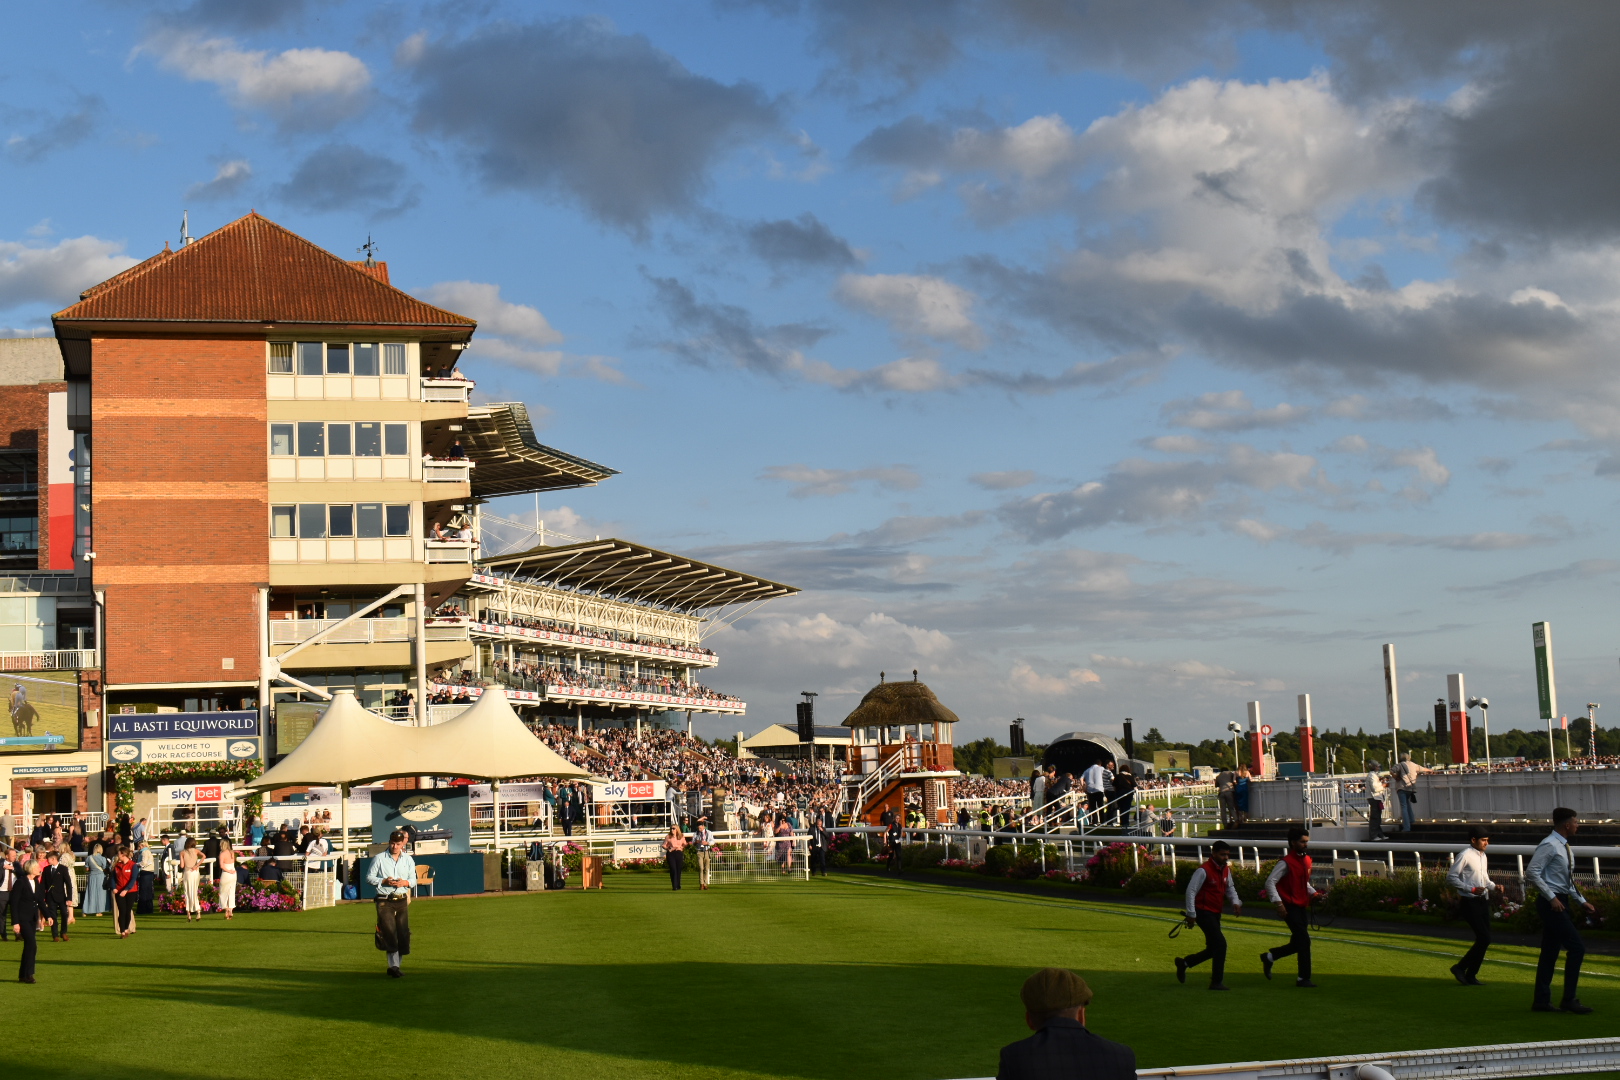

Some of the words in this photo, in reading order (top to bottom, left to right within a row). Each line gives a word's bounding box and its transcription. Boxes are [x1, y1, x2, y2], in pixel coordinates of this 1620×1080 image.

[1450, 700, 1459, 710] sky
[113, 722, 129, 733] AL
[134, 721, 168, 732] BASTI
[174, 719, 254, 733] EQUIWORLD
[158, 743, 199, 751] WELCOME
[171, 788, 192, 801] sky
[197, 787, 219, 798] bet
[605, 785, 625, 797] sky
[630, 784, 652, 795] bet
[628, 845, 643, 854] sky
[645, 845, 662, 853] bet
